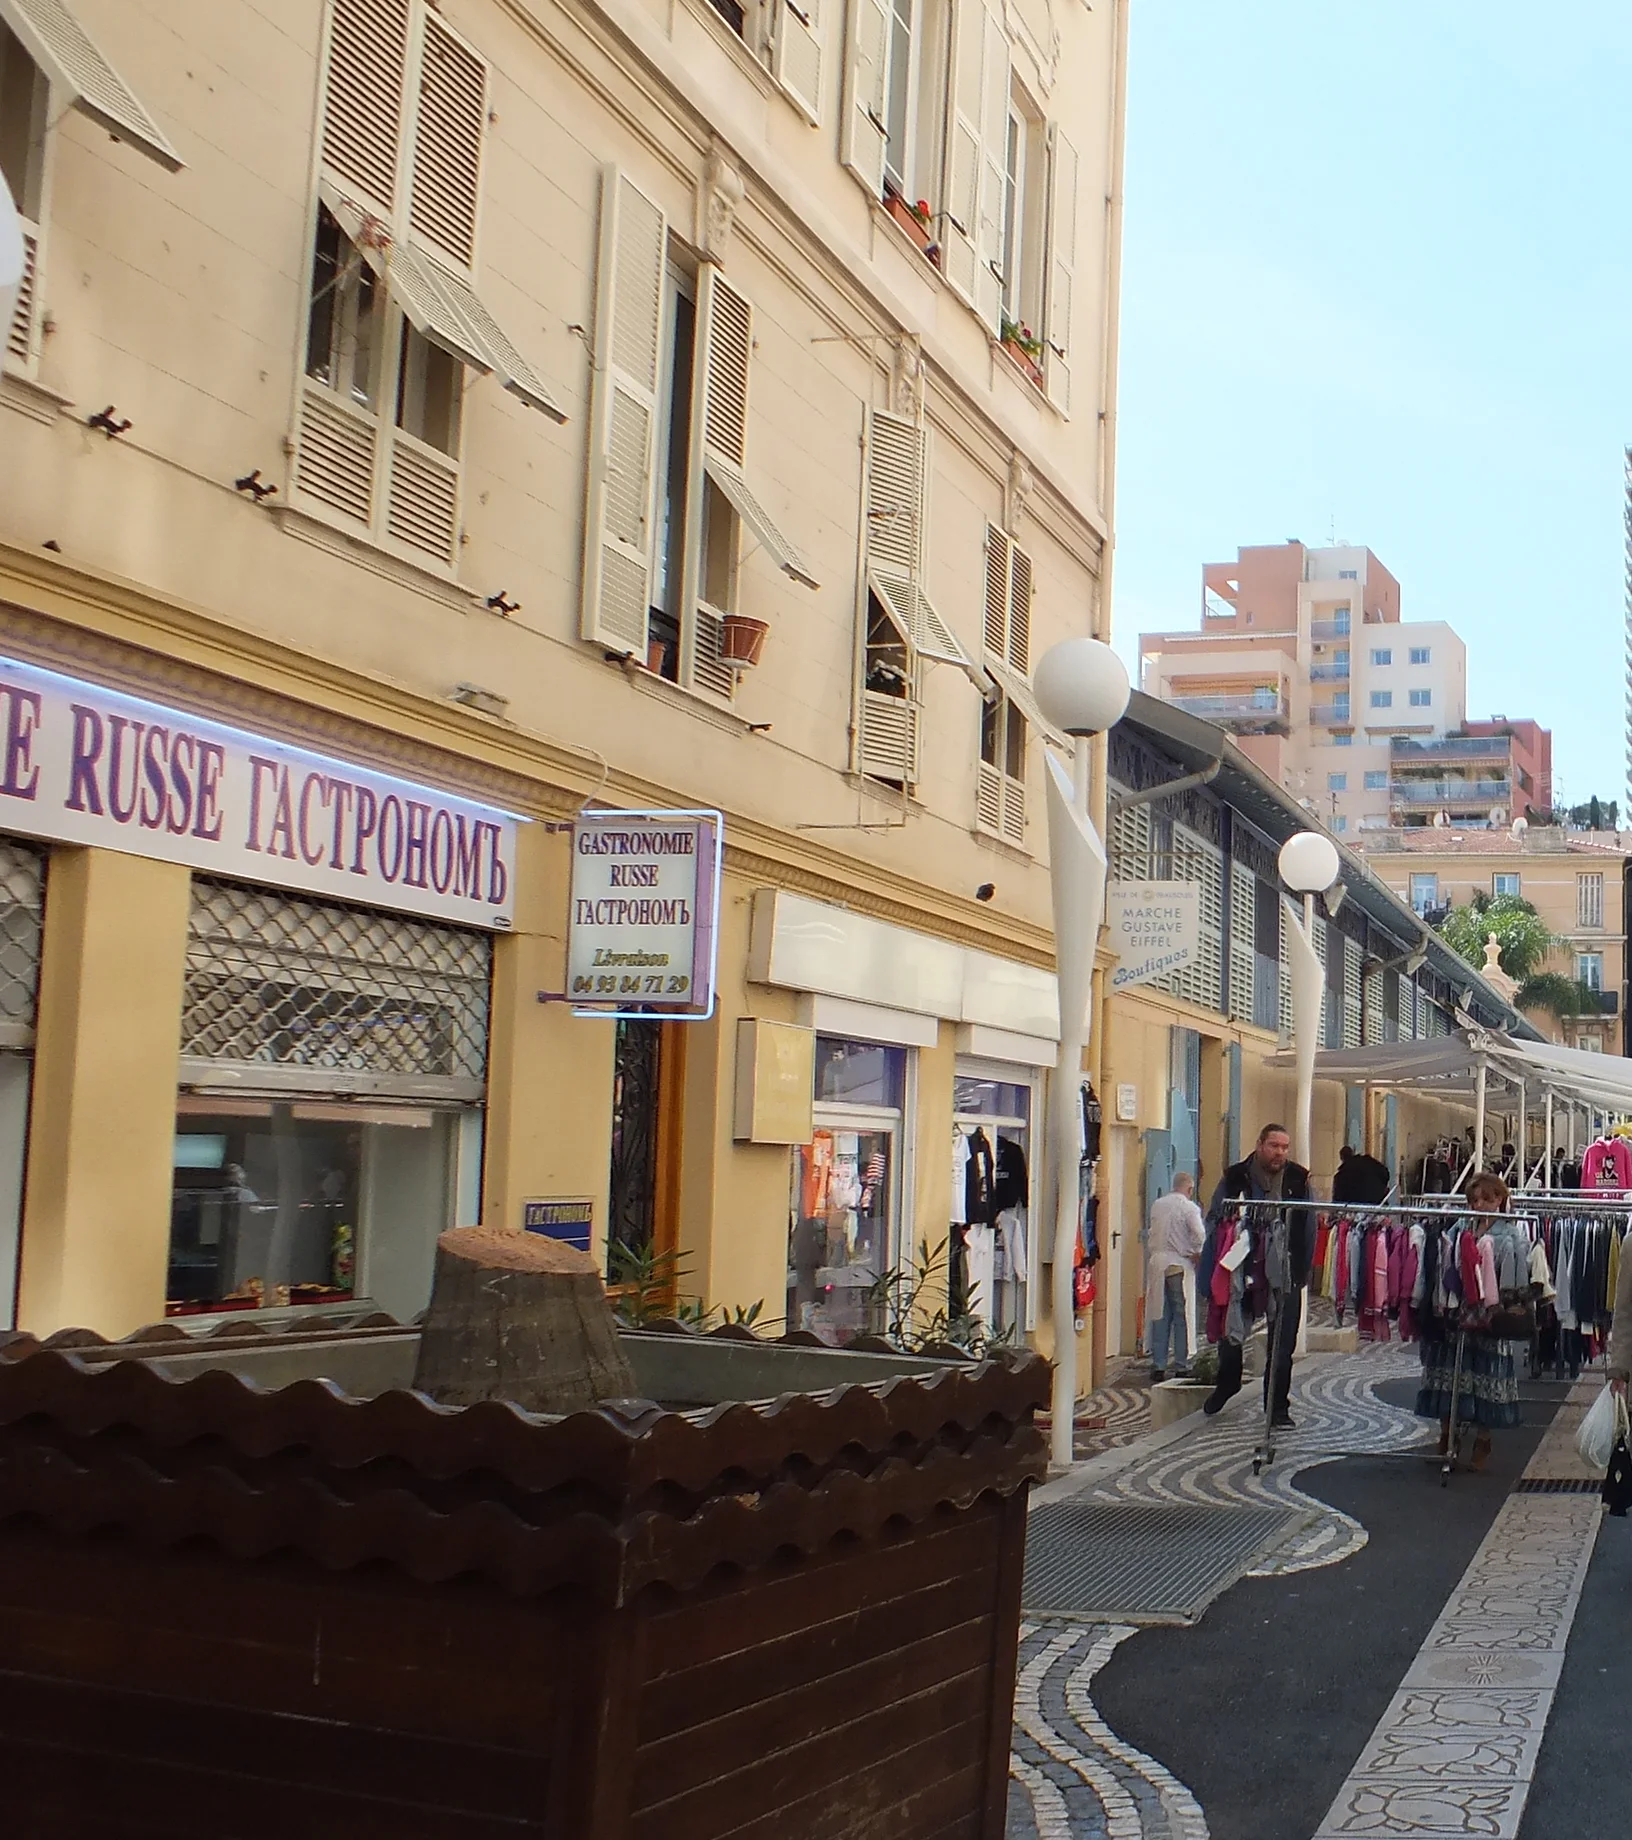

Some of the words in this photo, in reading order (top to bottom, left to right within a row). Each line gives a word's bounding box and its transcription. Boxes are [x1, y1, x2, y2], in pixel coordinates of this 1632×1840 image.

[0, 683, 42, 801] E
[64, 703, 225, 841] RUSSE
[245, 755, 508, 904] ГАСТРОНОМЪ
[578, 832, 693, 856] GASTRONOMIE
[609, 865, 659, 887] RUSSE
[576, 899, 690, 925] ГАСТРОНОМЪ
[1122, 908, 1182, 918] MARCHE
[1121, 921, 1183, 932] GUSTAVE
[1130, 936, 1171, 947] EIFFEL
[592, 949, 669, 967] Livraison
[1113, 948, 1188, 985] Boutiques
[573, 975, 593, 993] 04
[596, 975, 617, 993] 93
[620, 975, 641, 993] 84
[644, 976, 663, 993] 71
